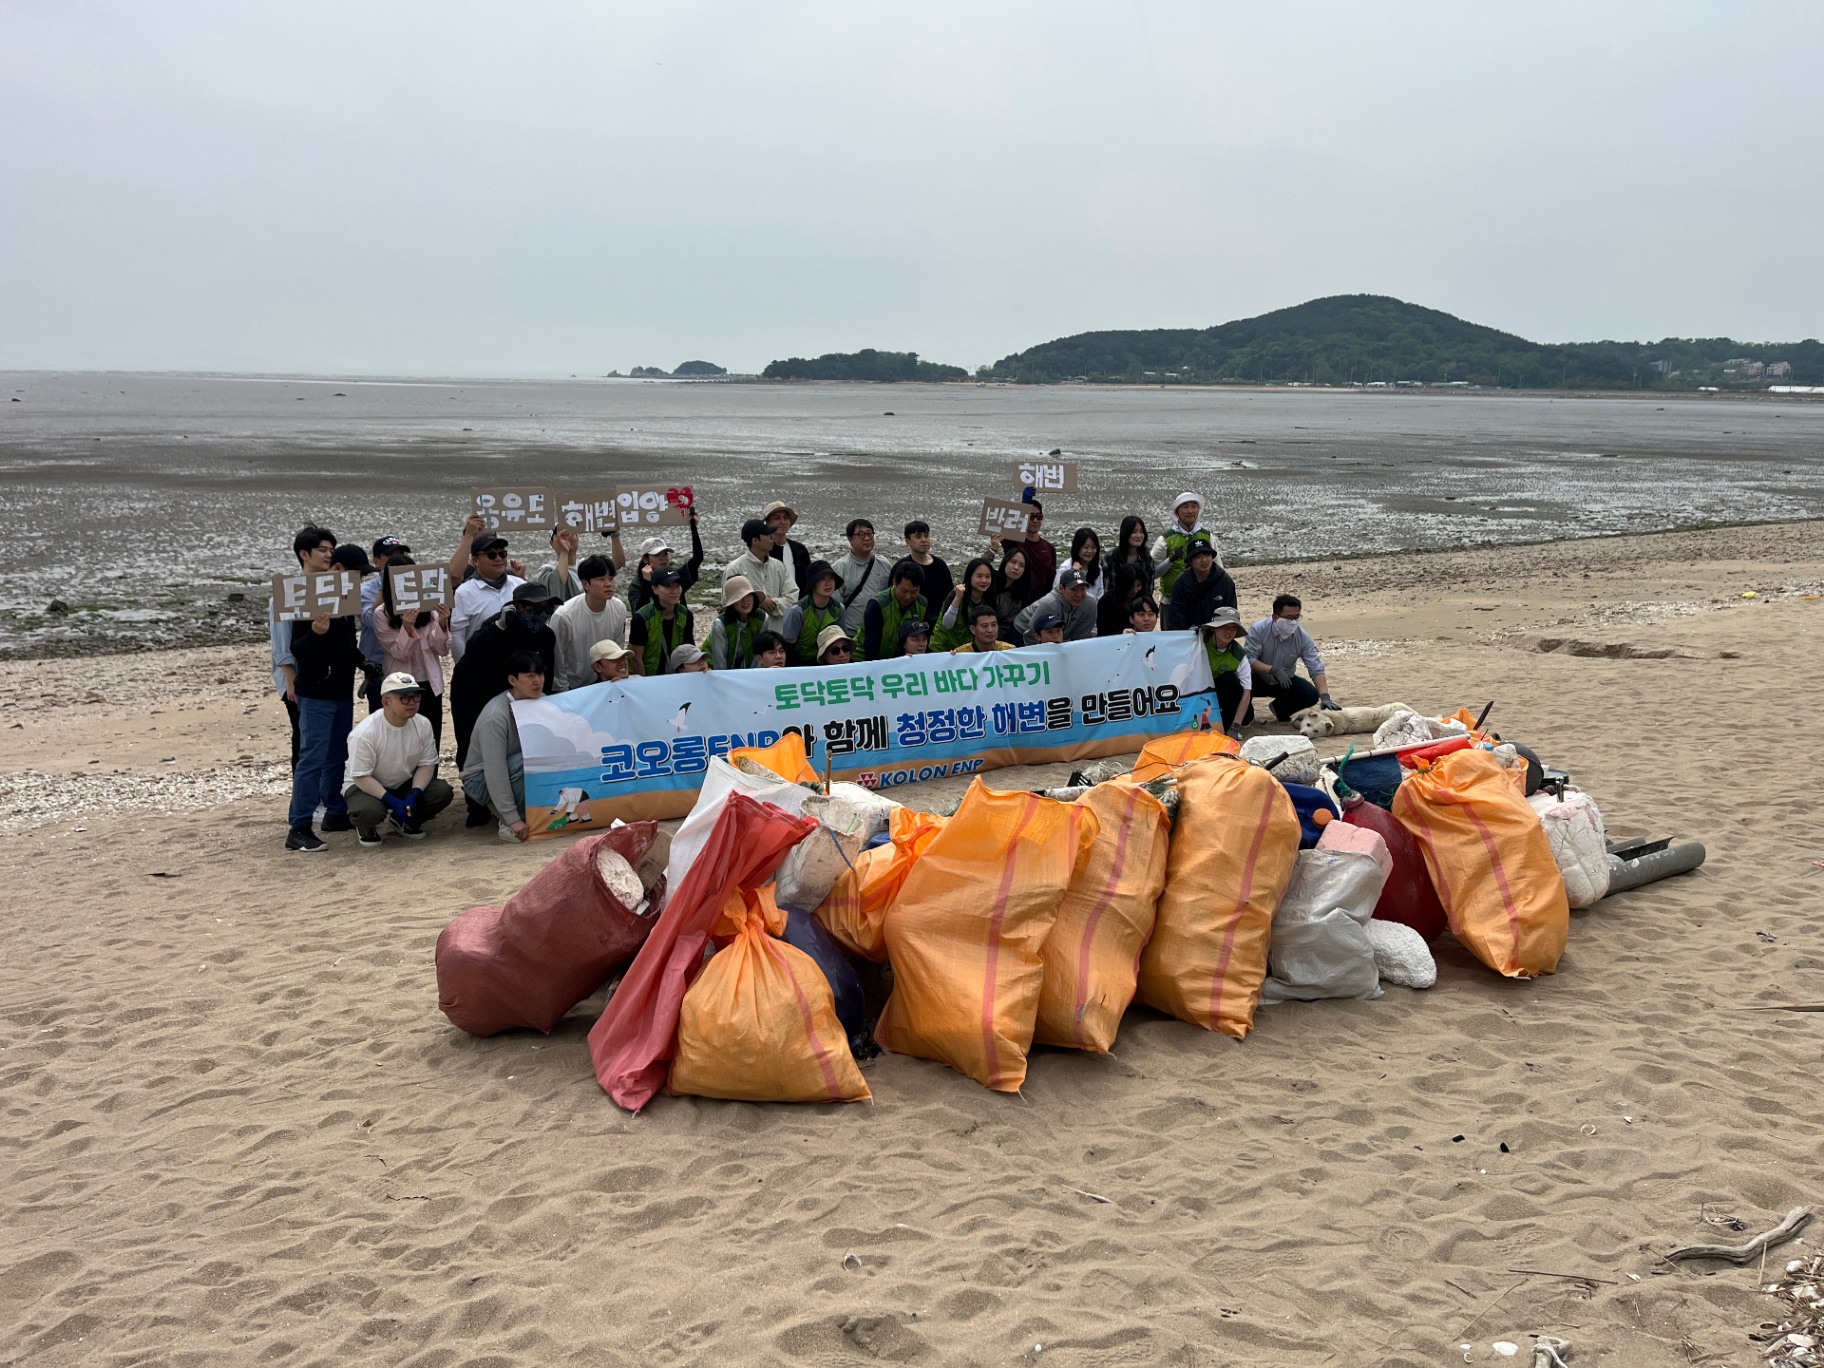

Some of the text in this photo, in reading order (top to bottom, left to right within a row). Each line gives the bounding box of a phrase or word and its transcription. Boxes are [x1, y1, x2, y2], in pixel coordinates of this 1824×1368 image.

[1018, 462, 1064, 489] 해변
[476, 492, 546, 529] 용유도
[561, 499, 616, 533] 해변
[616, 490, 669, 524] 입양
[984, 506, 1030, 533] 반려
[279, 571, 354, 621] 토닥
[393, 567, 448, 611] 토닥
[774, 660, 1051, 711] 토닥토닥 우리 바다 가꾸기
[822, 714, 890, 755] 함께
[896, 703, 987, 748] 청정한
[992, 695, 1074, 736] 해변을
[1081, 684, 1182, 728] 만들어요
[880, 759, 984, 788] KOLON ENP
